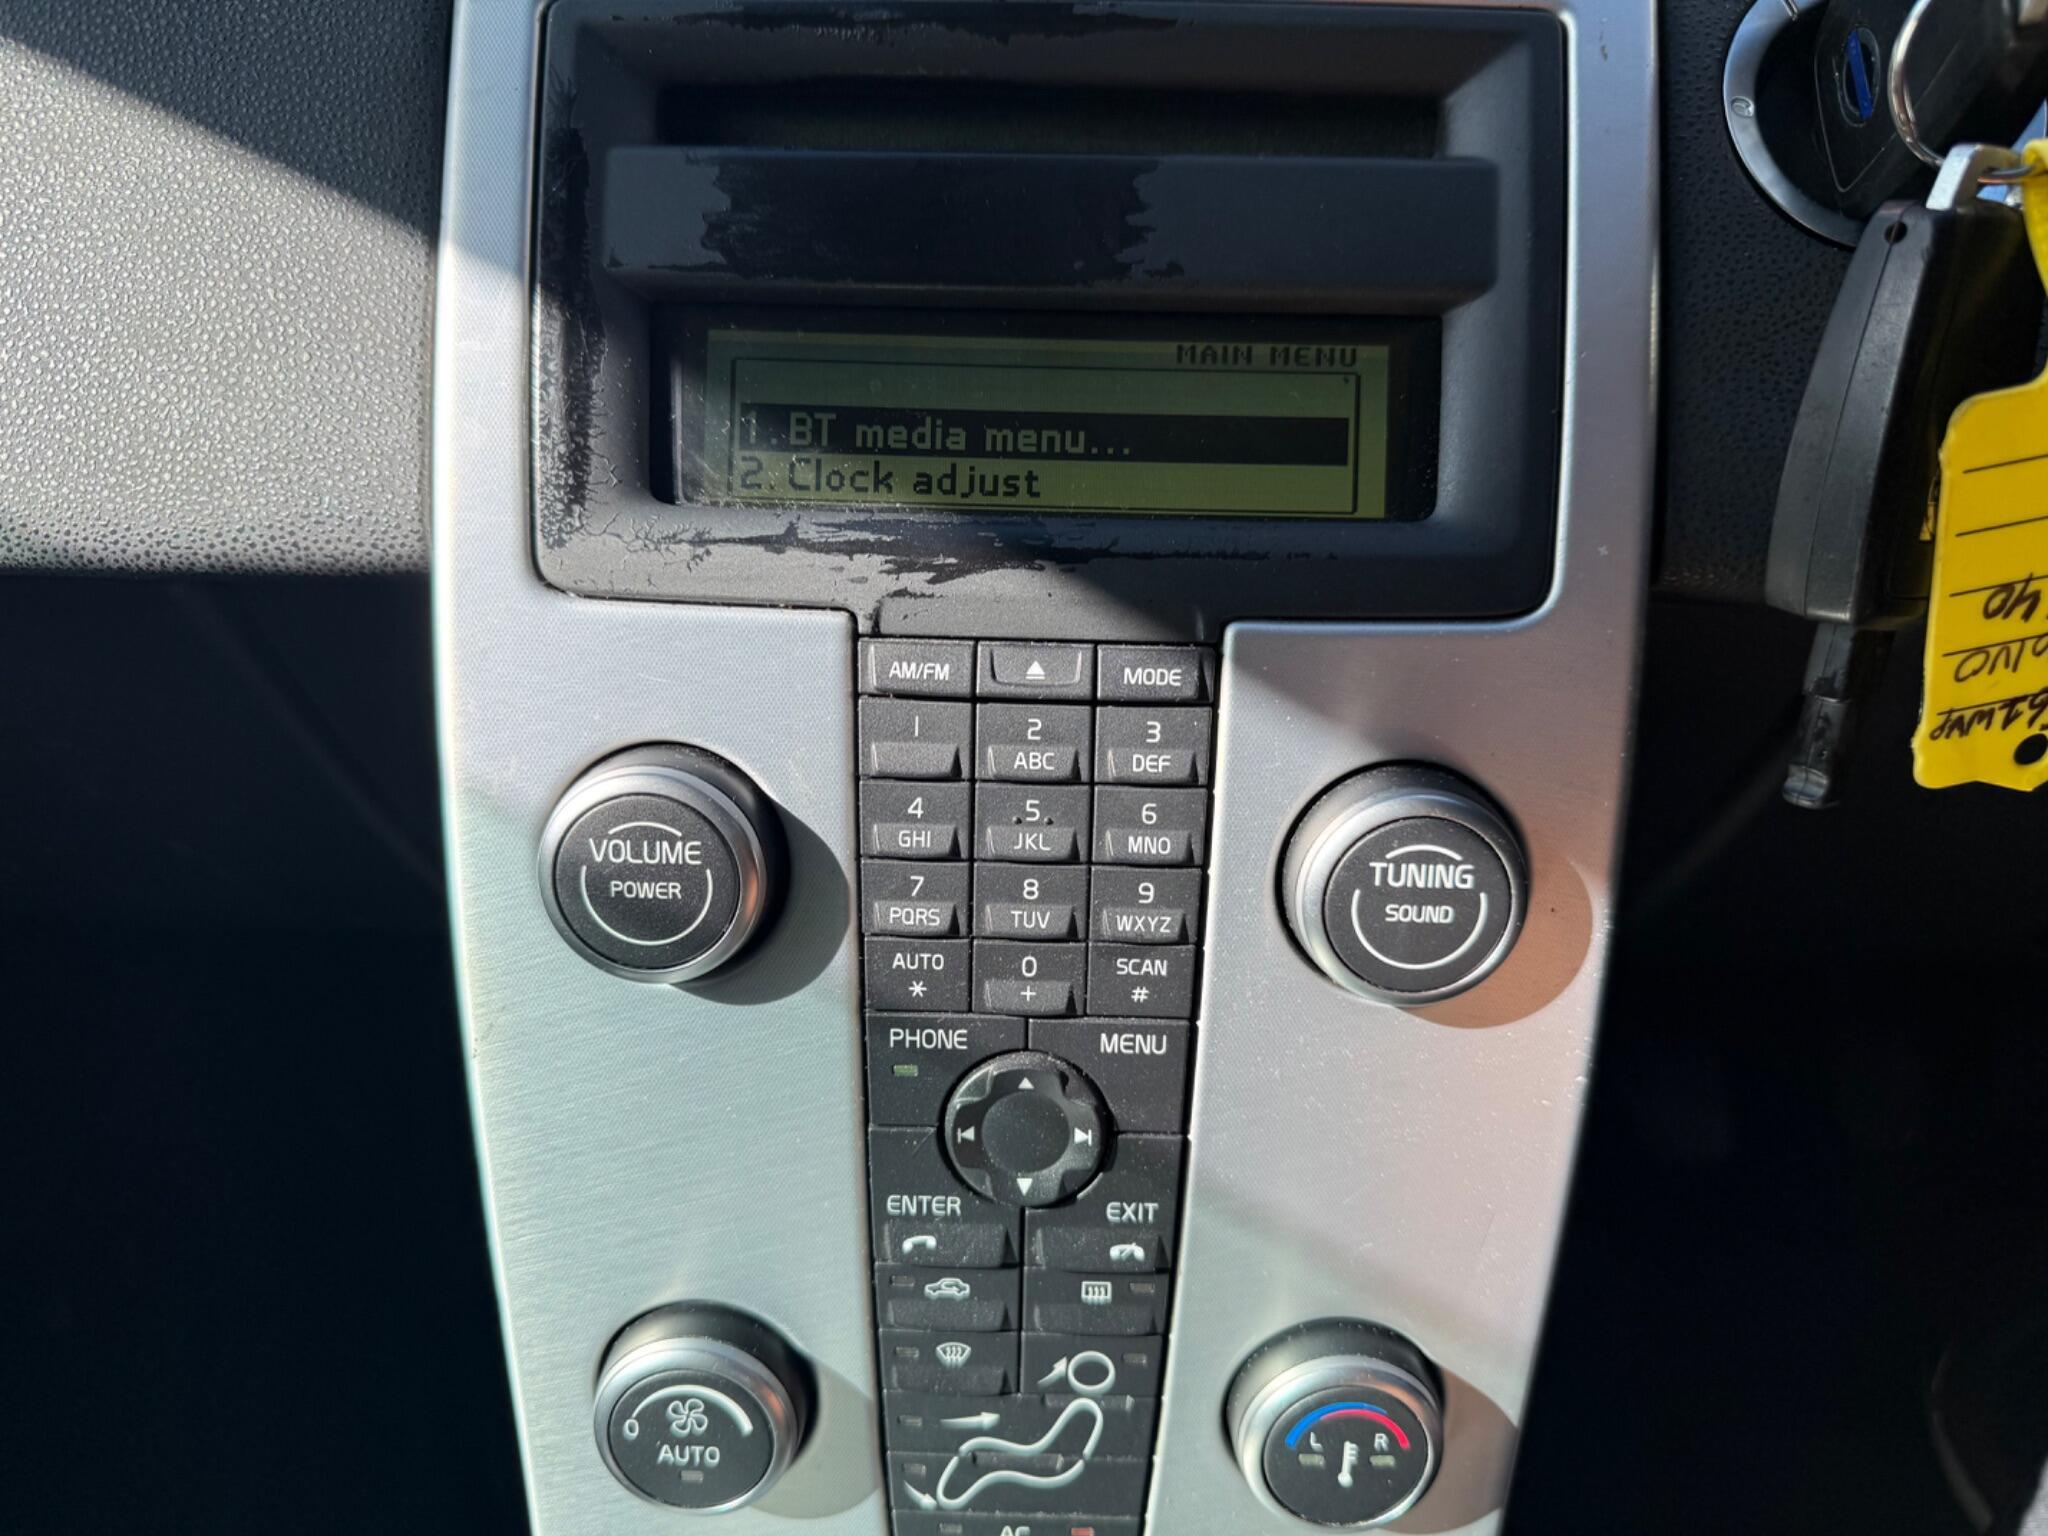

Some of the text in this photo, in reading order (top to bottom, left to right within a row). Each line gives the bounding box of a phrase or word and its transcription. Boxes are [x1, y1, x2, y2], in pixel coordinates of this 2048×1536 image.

[1175, 343, 1358, 368] MAIN MENU
[855, 415, 967, 450] media
[985, 426, 1131, 456] menu...
[787, 455, 894, 494] Clock
[912, 461, 1041, 499] adjust
[1982, 572, 2048, 623] 40
[888, 660, 950, 681] AM/FM
[1123, 667, 1182, 687] MODE
[1027, 718, 1042, 741] 2
[1145, 720, 1162, 743] 3
[1013, 751, 1055, 771] ABC
[1132, 753, 1172, 773] DEF
[907, 796, 924, 819] 4
[1025, 799, 1041, 822] 5
[1141, 802, 1157, 825] 6
[898, 829, 931, 848] GHI
[1013, 832, 1051, 851] JKL
[1128, 835, 1171, 855] MNO
[588, 837, 702, 865] VOLUME
[910, 875, 925, 897] 7
[1368, 861, 1474, 890] TUNING
[610, 880, 682, 900] POWER
[1022, 878, 1039, 900] 8
[1138, 882, 1155, 904] 9
[889, 908, 941, 927] PQRS
[1010, 910, 1051, 929] TUV
[1116, 914, 1172, 933] WXYZ
[1384, 903, 1454, 924] SOUND
[892, 952, 945, 971] AUTO
[1021, 955, 1038, 978] 0
[1116, 958, 1168, 977] SCAN
[889, 1028, 968, 1050] PHONE
[1100, 1032, 1167, 1055] MENU
[886, 1194, 962, 1217] ENTER
[1106, 1201, 1159, 1223] EXIT
[1309, 1431, 1324, 1452] L
[1373, 1432, 1390, 1451] R
[656, 1444, 721, 1468] AUTO
